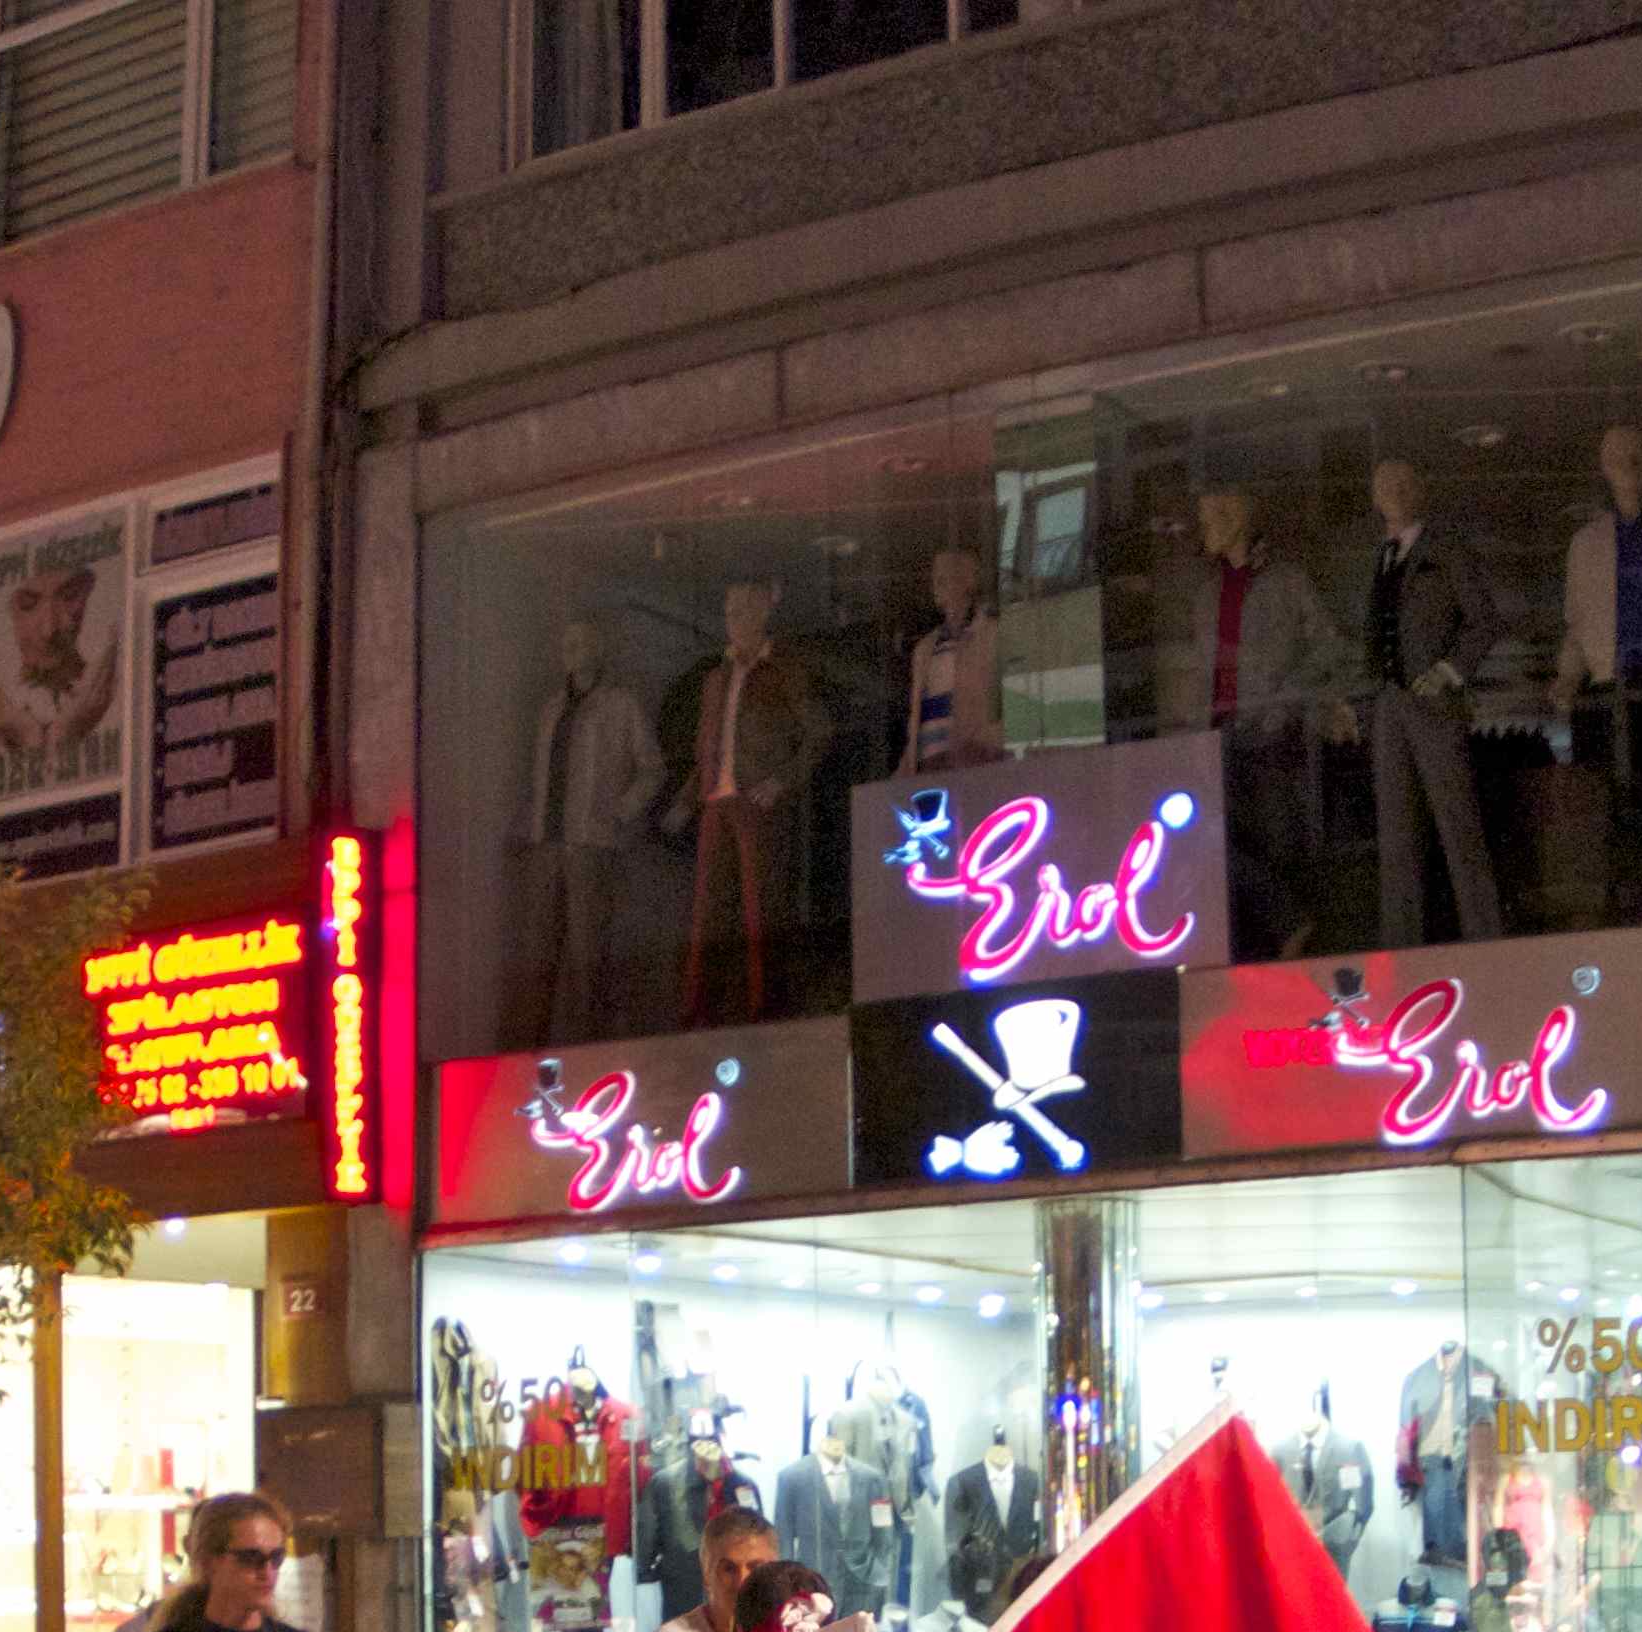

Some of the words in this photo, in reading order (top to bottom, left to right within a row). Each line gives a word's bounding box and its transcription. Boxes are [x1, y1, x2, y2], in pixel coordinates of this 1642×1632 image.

[907, 795, 1195, 982] Erol
[1329, 976, 1609, 1146] Erol
[529, 1069, 743, 1213] Erol
[290, 1289, 316, 1313] 22
[480, 1376, 566, 1424] %50
